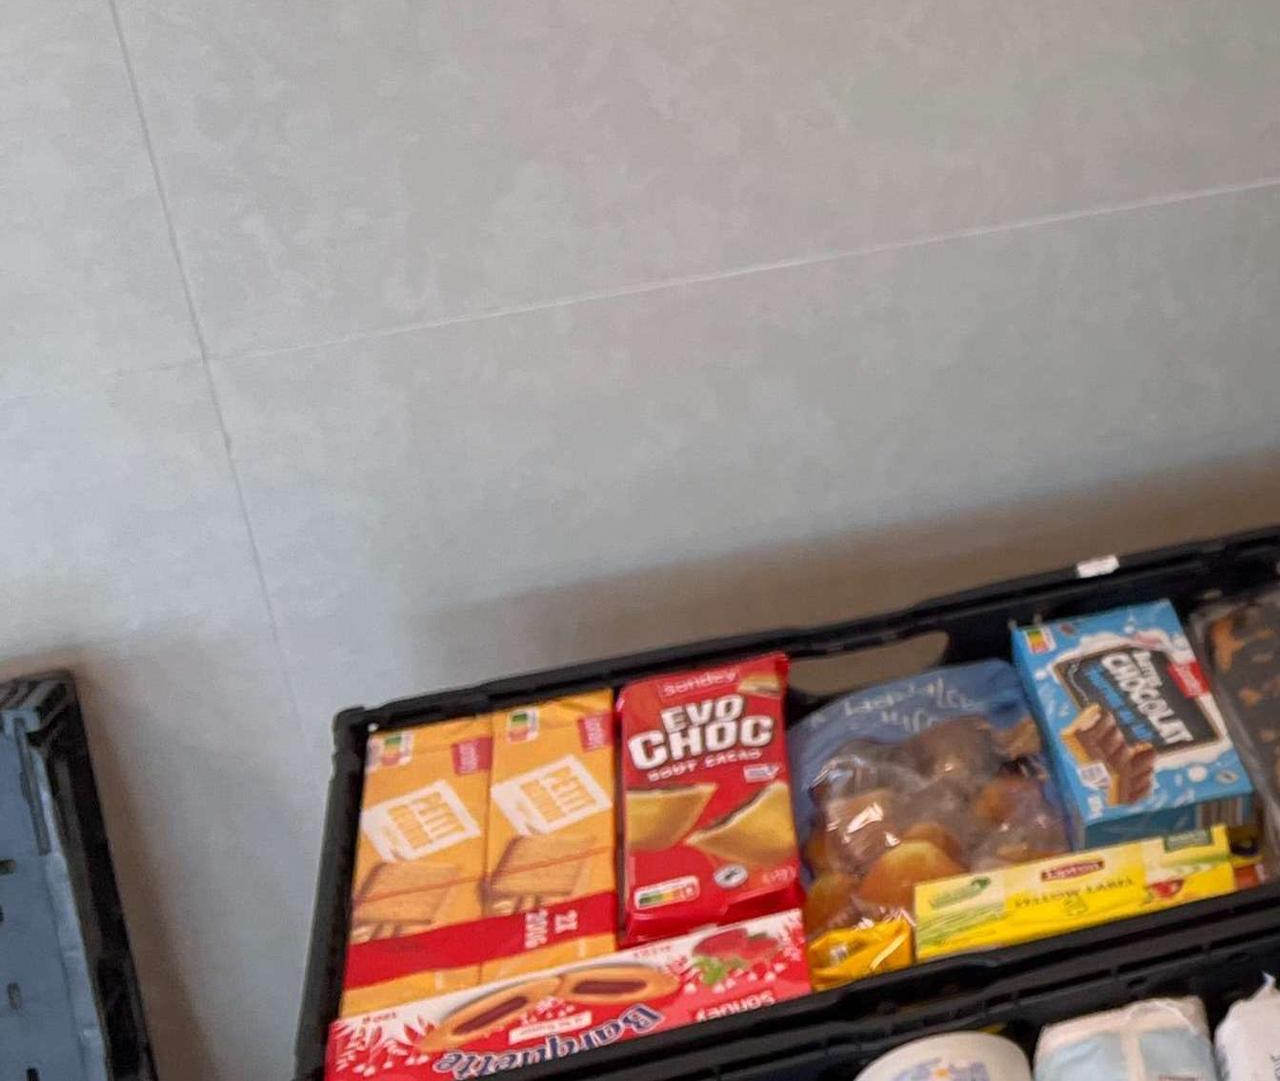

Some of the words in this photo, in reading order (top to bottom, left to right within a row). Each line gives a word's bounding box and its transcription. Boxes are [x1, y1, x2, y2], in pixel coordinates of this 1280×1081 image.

[660, 694, 744, 734] EVO
[628, 715, 773, 770] CHOC
[1045, 862, 1099, 880] Lipton
[433, 1002, 664, 1080] Barquette
